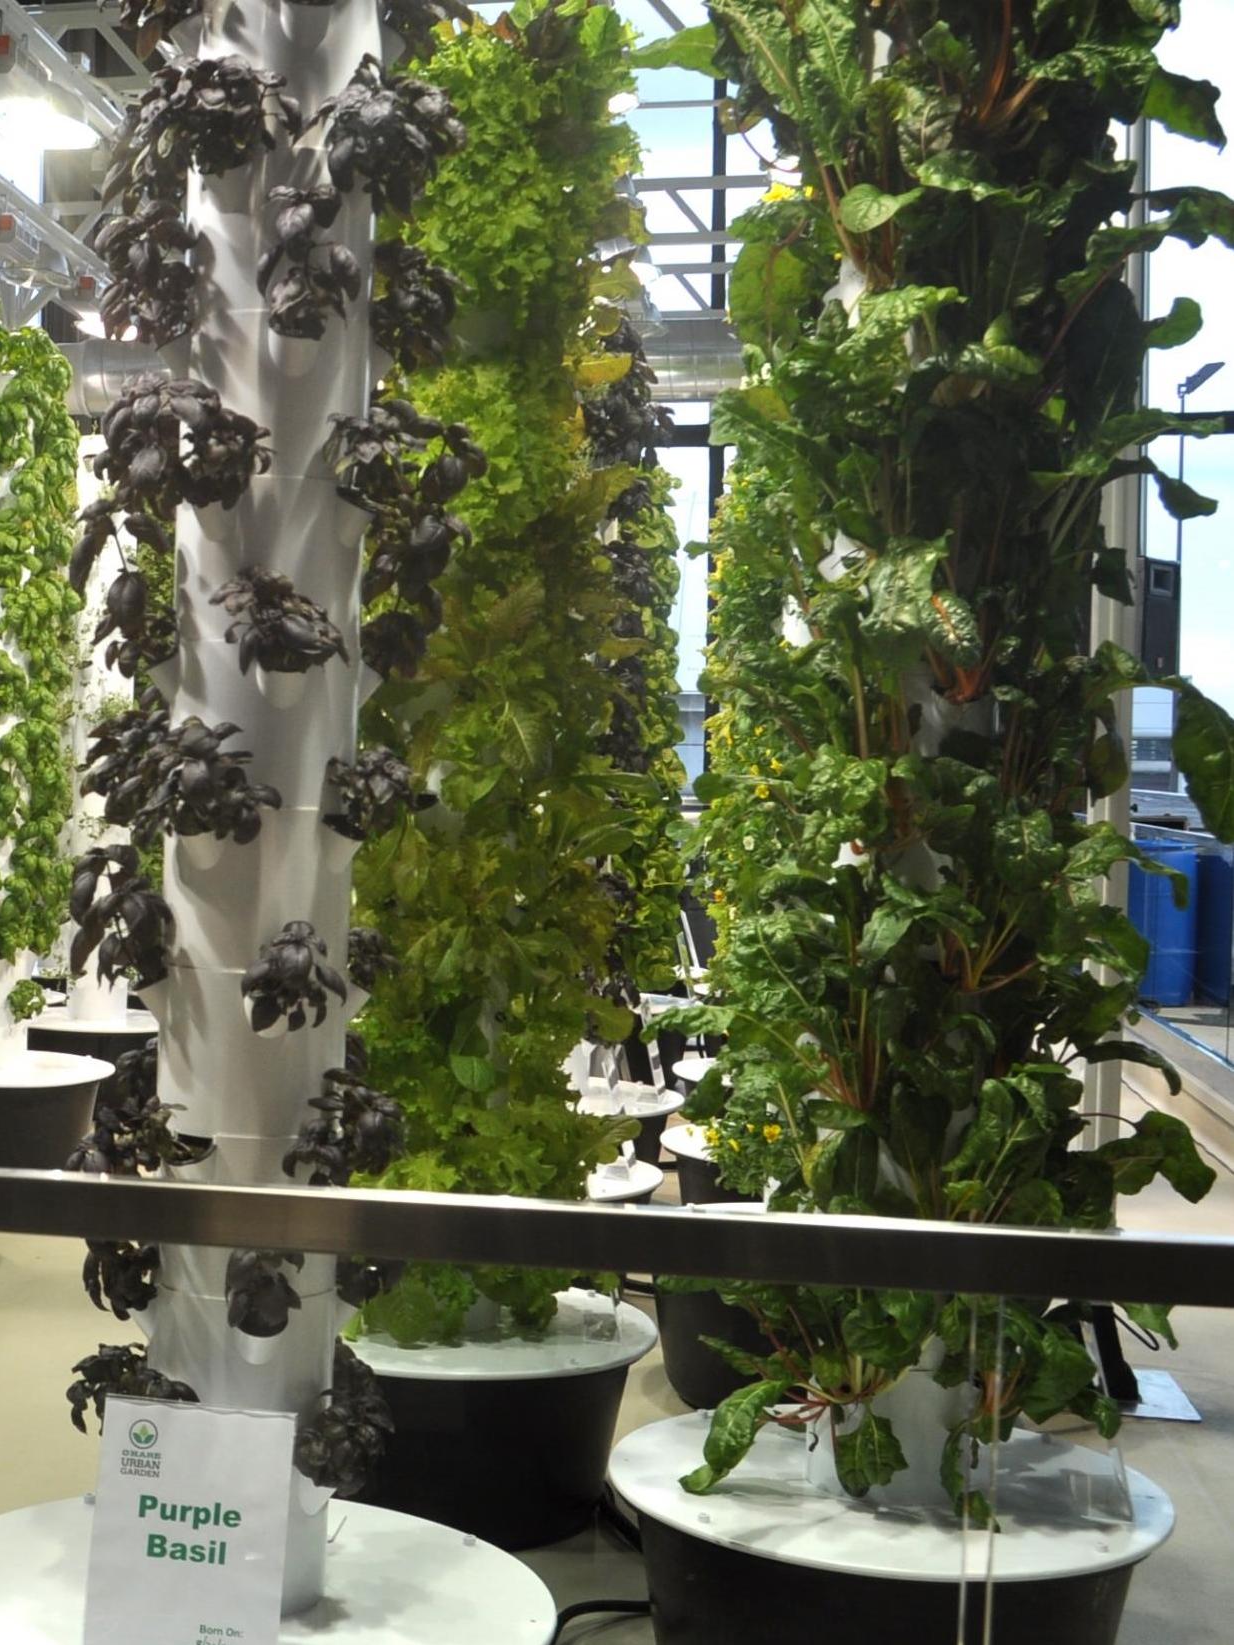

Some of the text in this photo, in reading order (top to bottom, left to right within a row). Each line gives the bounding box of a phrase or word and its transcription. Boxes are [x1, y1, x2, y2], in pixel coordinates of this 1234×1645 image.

[120, 1457, 161, 1470] URBAN
[119, 1467, 160, 1478] GARDEN
[138, 1494, 242, 1530] Purple
[146, 1533, 227, 1565] Basil
[199, 1624, 223, 1636] Born
